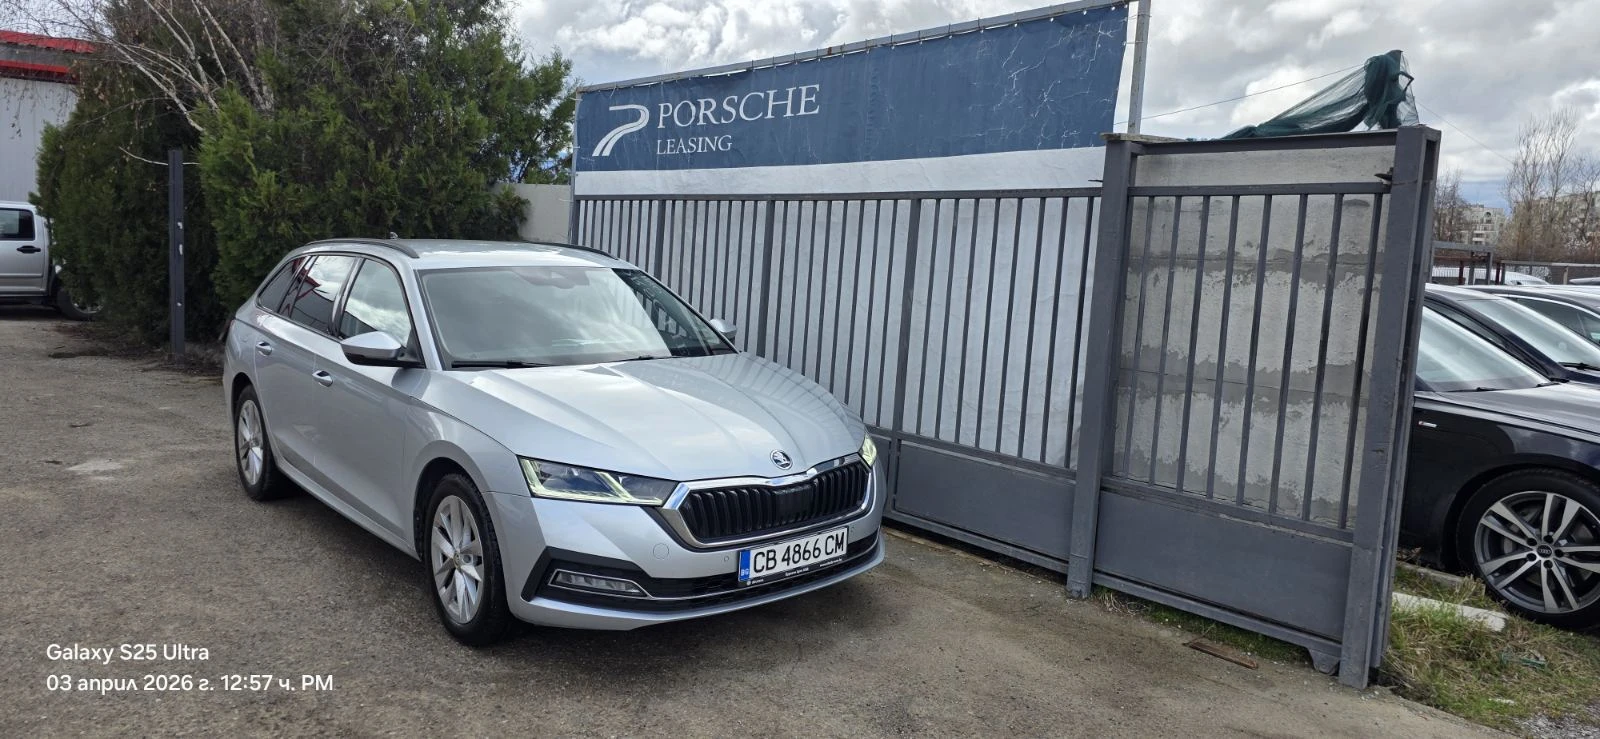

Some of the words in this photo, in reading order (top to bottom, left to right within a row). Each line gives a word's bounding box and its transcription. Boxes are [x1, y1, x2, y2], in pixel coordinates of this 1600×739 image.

[658, 83, 820, 129] PORSCHE
[657, 134, 732, 155] LEASING
[753, 549, 777, 573] CB
[781, 538, 821, 566] 4866
[825, 531, 845, 556] CM
[741, 568, 749, 576] BG
